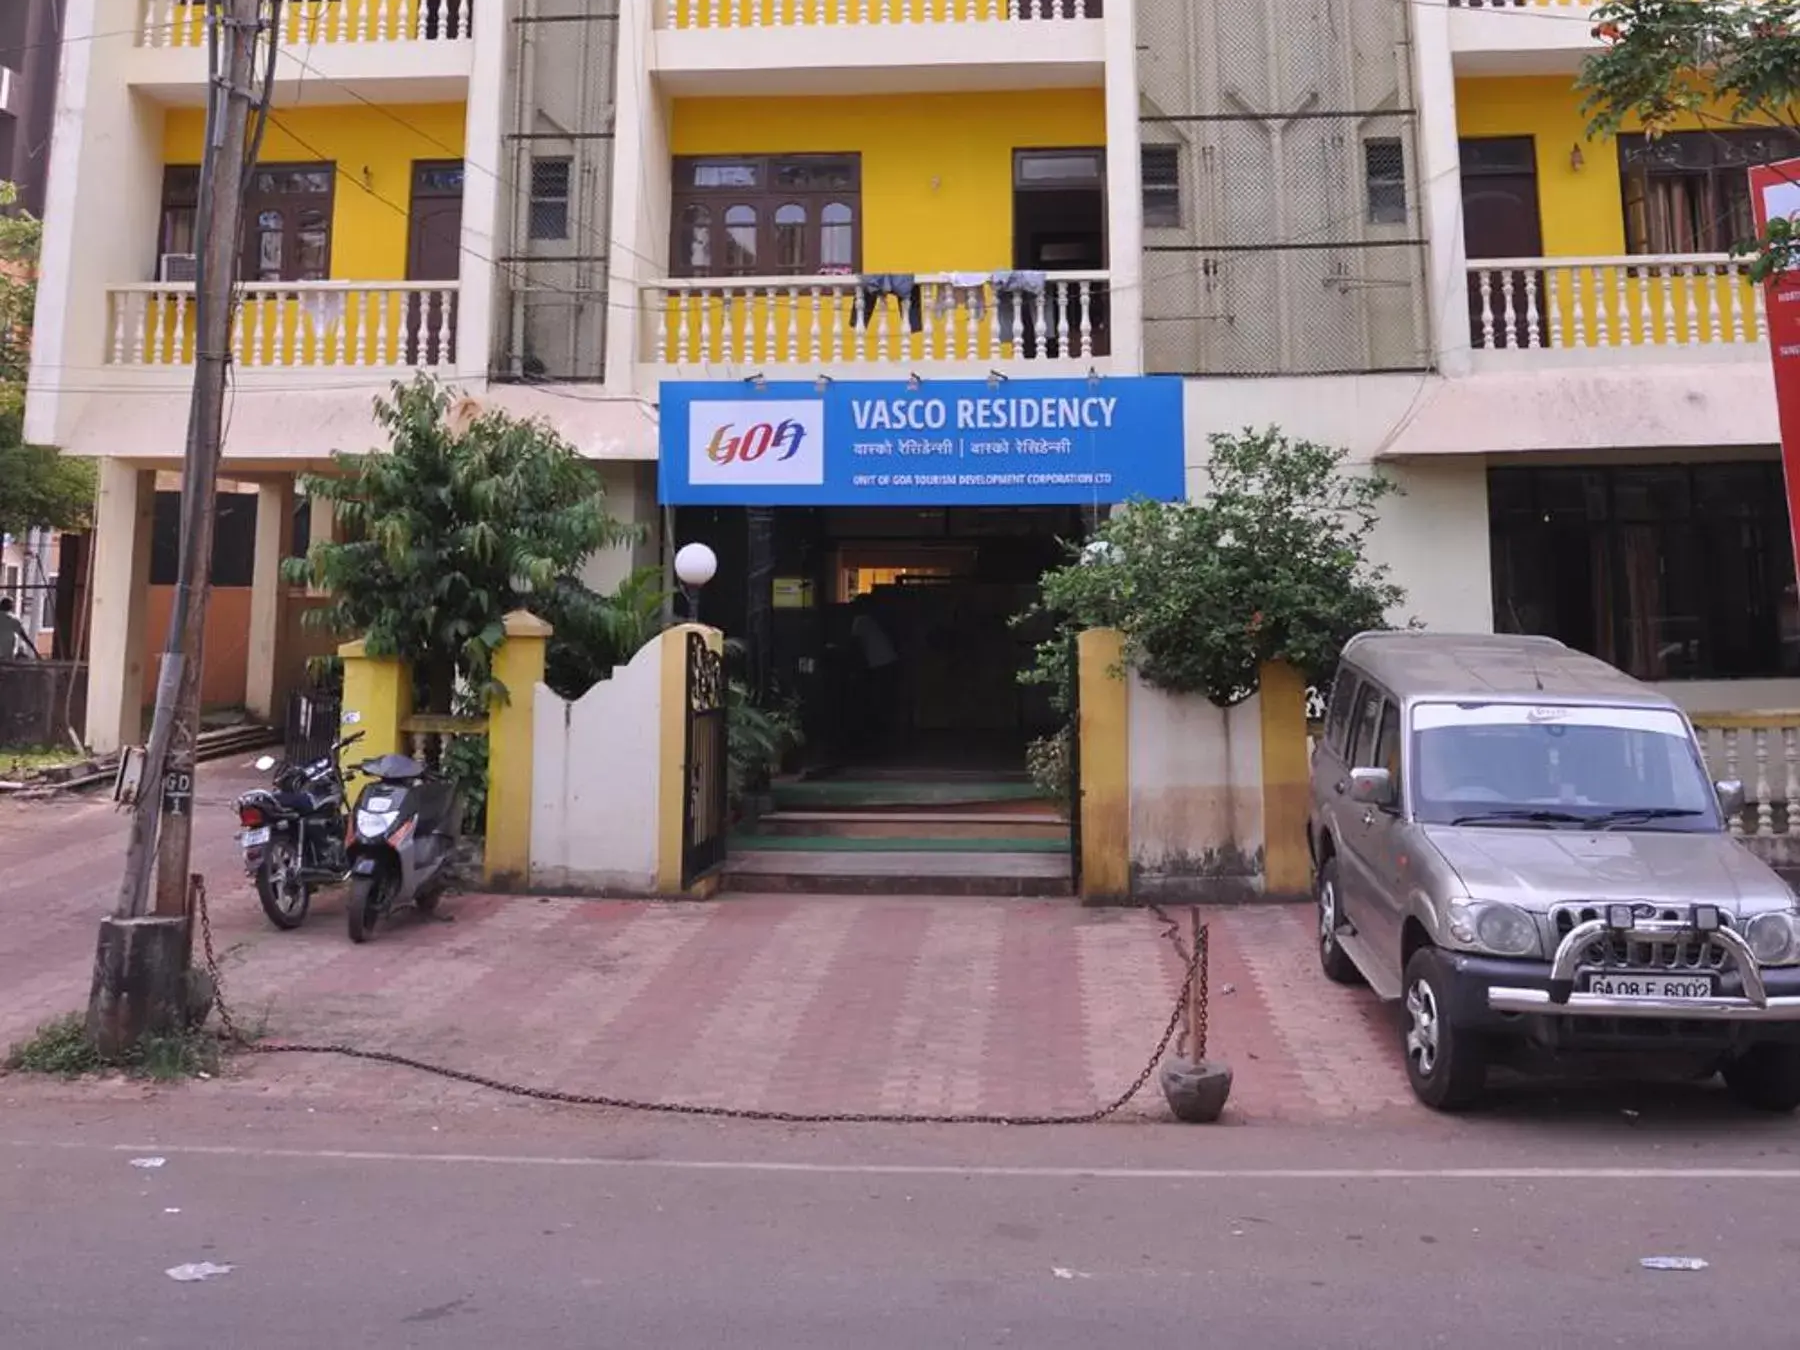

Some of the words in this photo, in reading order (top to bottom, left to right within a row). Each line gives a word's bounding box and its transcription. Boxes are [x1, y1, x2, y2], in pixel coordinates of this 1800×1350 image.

[852, 398, 946, 430] VASCO
[957, 396, 1117, 429] RESIDENCY
[706, 418, 806, 466] GOA
[853, 474, 876, 486] UNIT
[877, 474, 889, 486] OF
[892, 474, 912, 486] GOA
[914, 474, 956, 486] TOURISM
[959, 473, 1025, 486] DEVELOPMENT
[1027, 473, 1093, 485] CORPORATION
[1094, 473, 1112, 484] LTD
